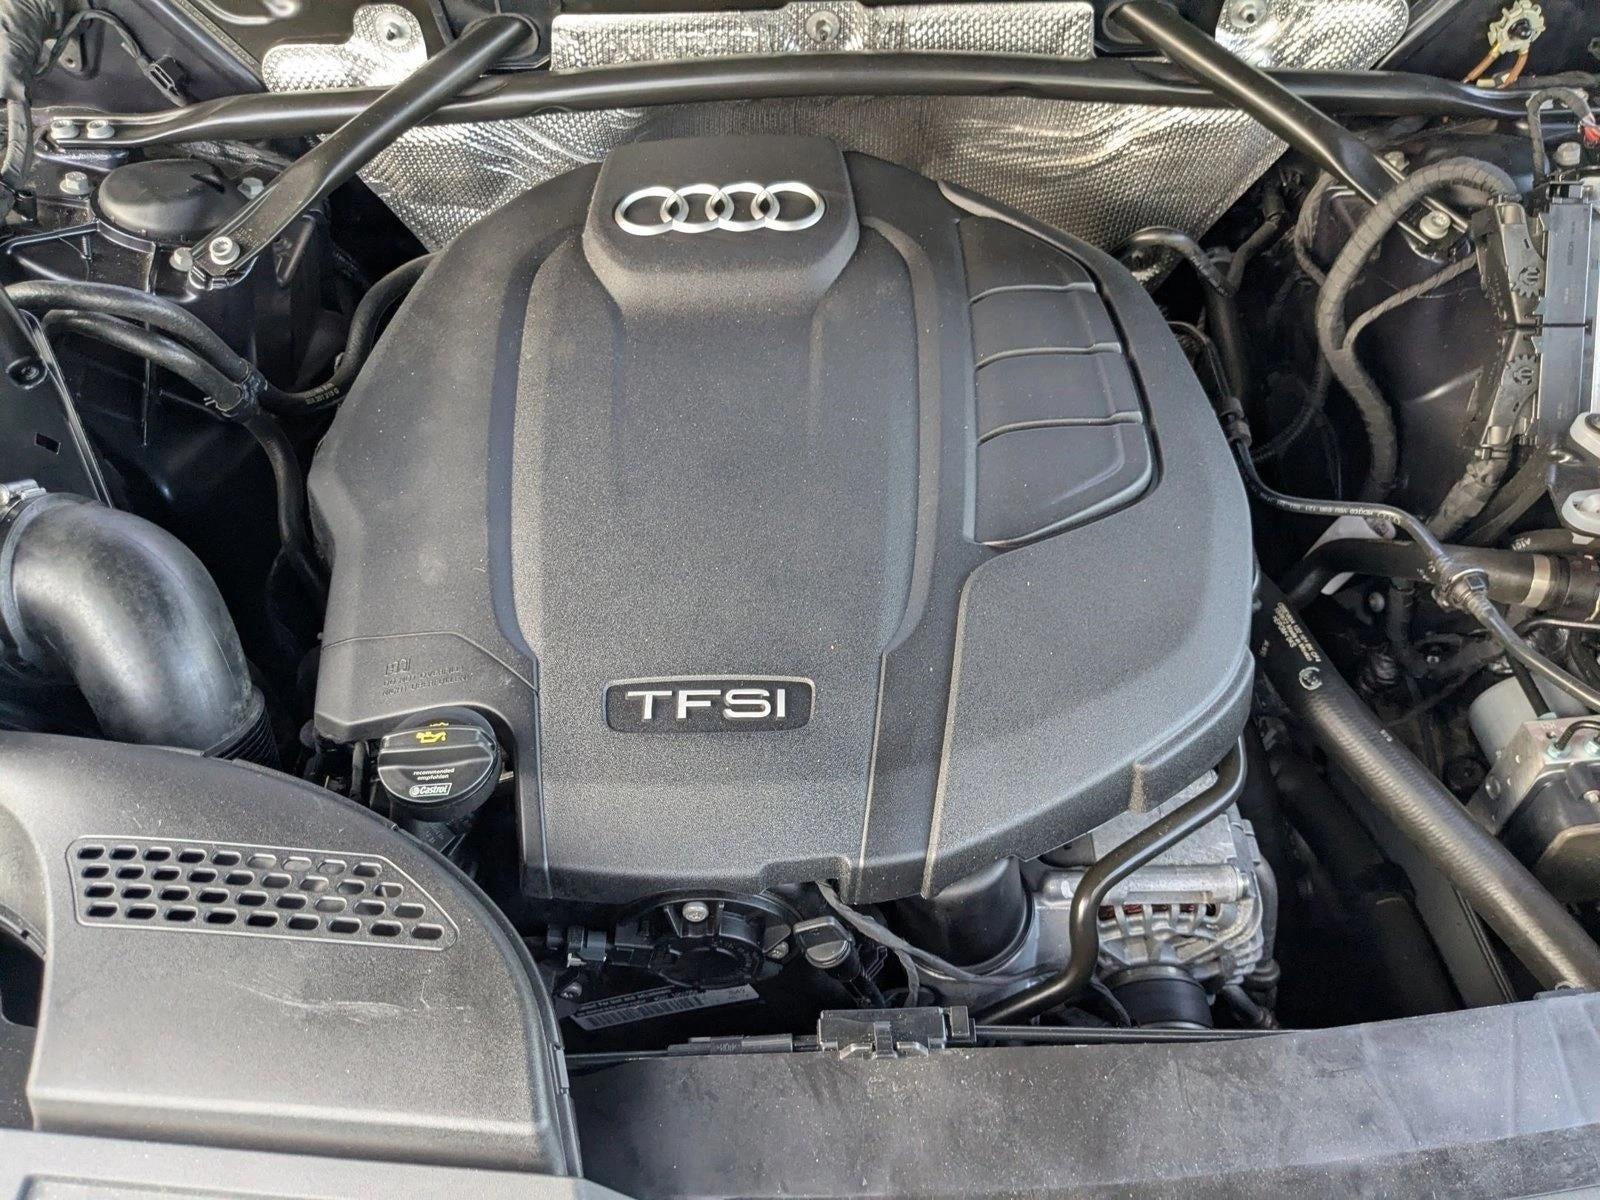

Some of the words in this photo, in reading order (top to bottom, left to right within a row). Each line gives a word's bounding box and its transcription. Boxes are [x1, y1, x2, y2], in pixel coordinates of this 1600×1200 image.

[626, 688, 786, 721] TFSI
[413, 767, 455, 776] recommended
[419, 784, 448, 795] Castrol
